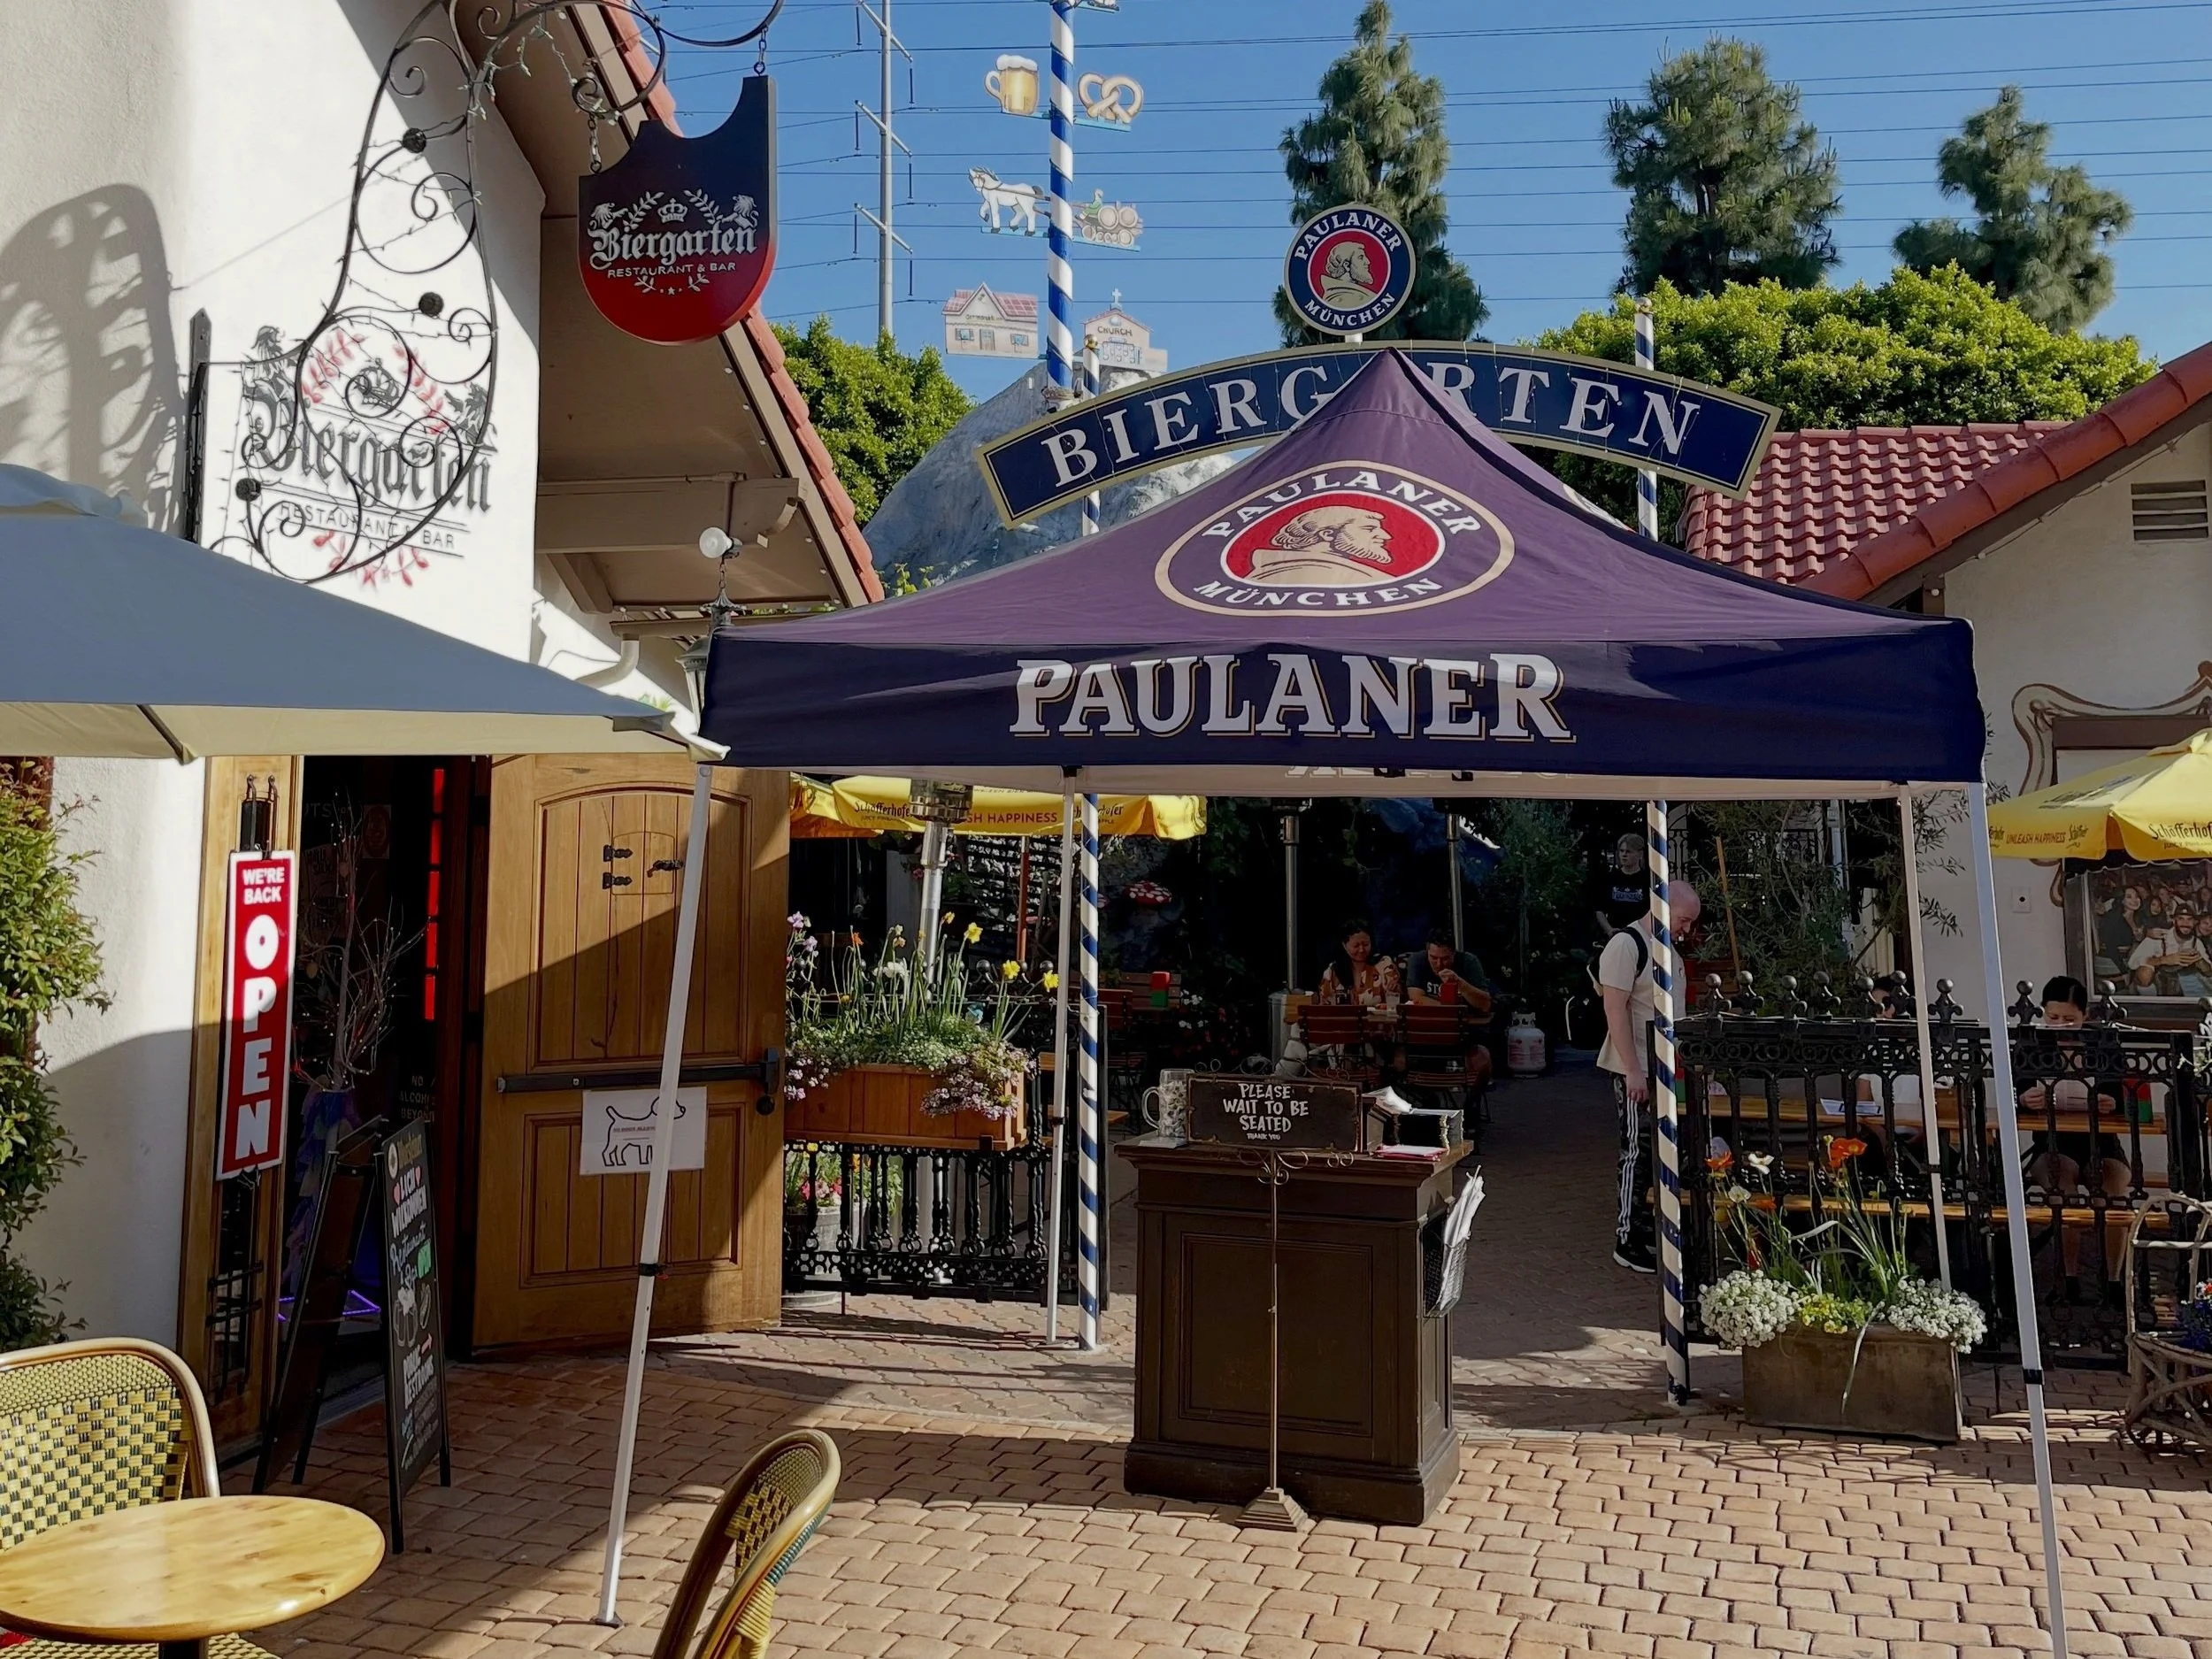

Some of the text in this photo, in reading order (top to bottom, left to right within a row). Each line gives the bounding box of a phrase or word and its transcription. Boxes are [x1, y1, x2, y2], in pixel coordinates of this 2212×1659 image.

[1294, 211, 1402, 260] PAULANER
[588, 221, 757, 270] Biergarten
[607, 265, 694, 279] RESTAURANT
[710, 262, 736, 272] BAR
[1304, 292, 1395, 326] MÜNCHEN
[1041, 358, 1701, 488] BIERGRTEN
[1201, 469, 1482, 538] PAULANER
[423, 531, 455, 547] BAR
[1193, 577, 1443, 606] MÜNCHEN
[1009, 652, 1578, 743] PAULANER
[855, 802, 910, 818] Schöfferhofe
[987, 812, 1057, 824] HAPPINESS
[2006, 833, 2033, 844] UNLEASH
[2034, 832, 2067, 843] HAPPINESS
[242, 867, 285, 886] WE'RE
[244, 886, 282, 904] BACK
[234, 914, 280, 1162] OPEN
[1239, 1083, 1291, 1100] PLEASE
[1223, 1099, 1310, 1117] WAIT TO BE
[1239, 1115, 1292, 1133] SEATED
